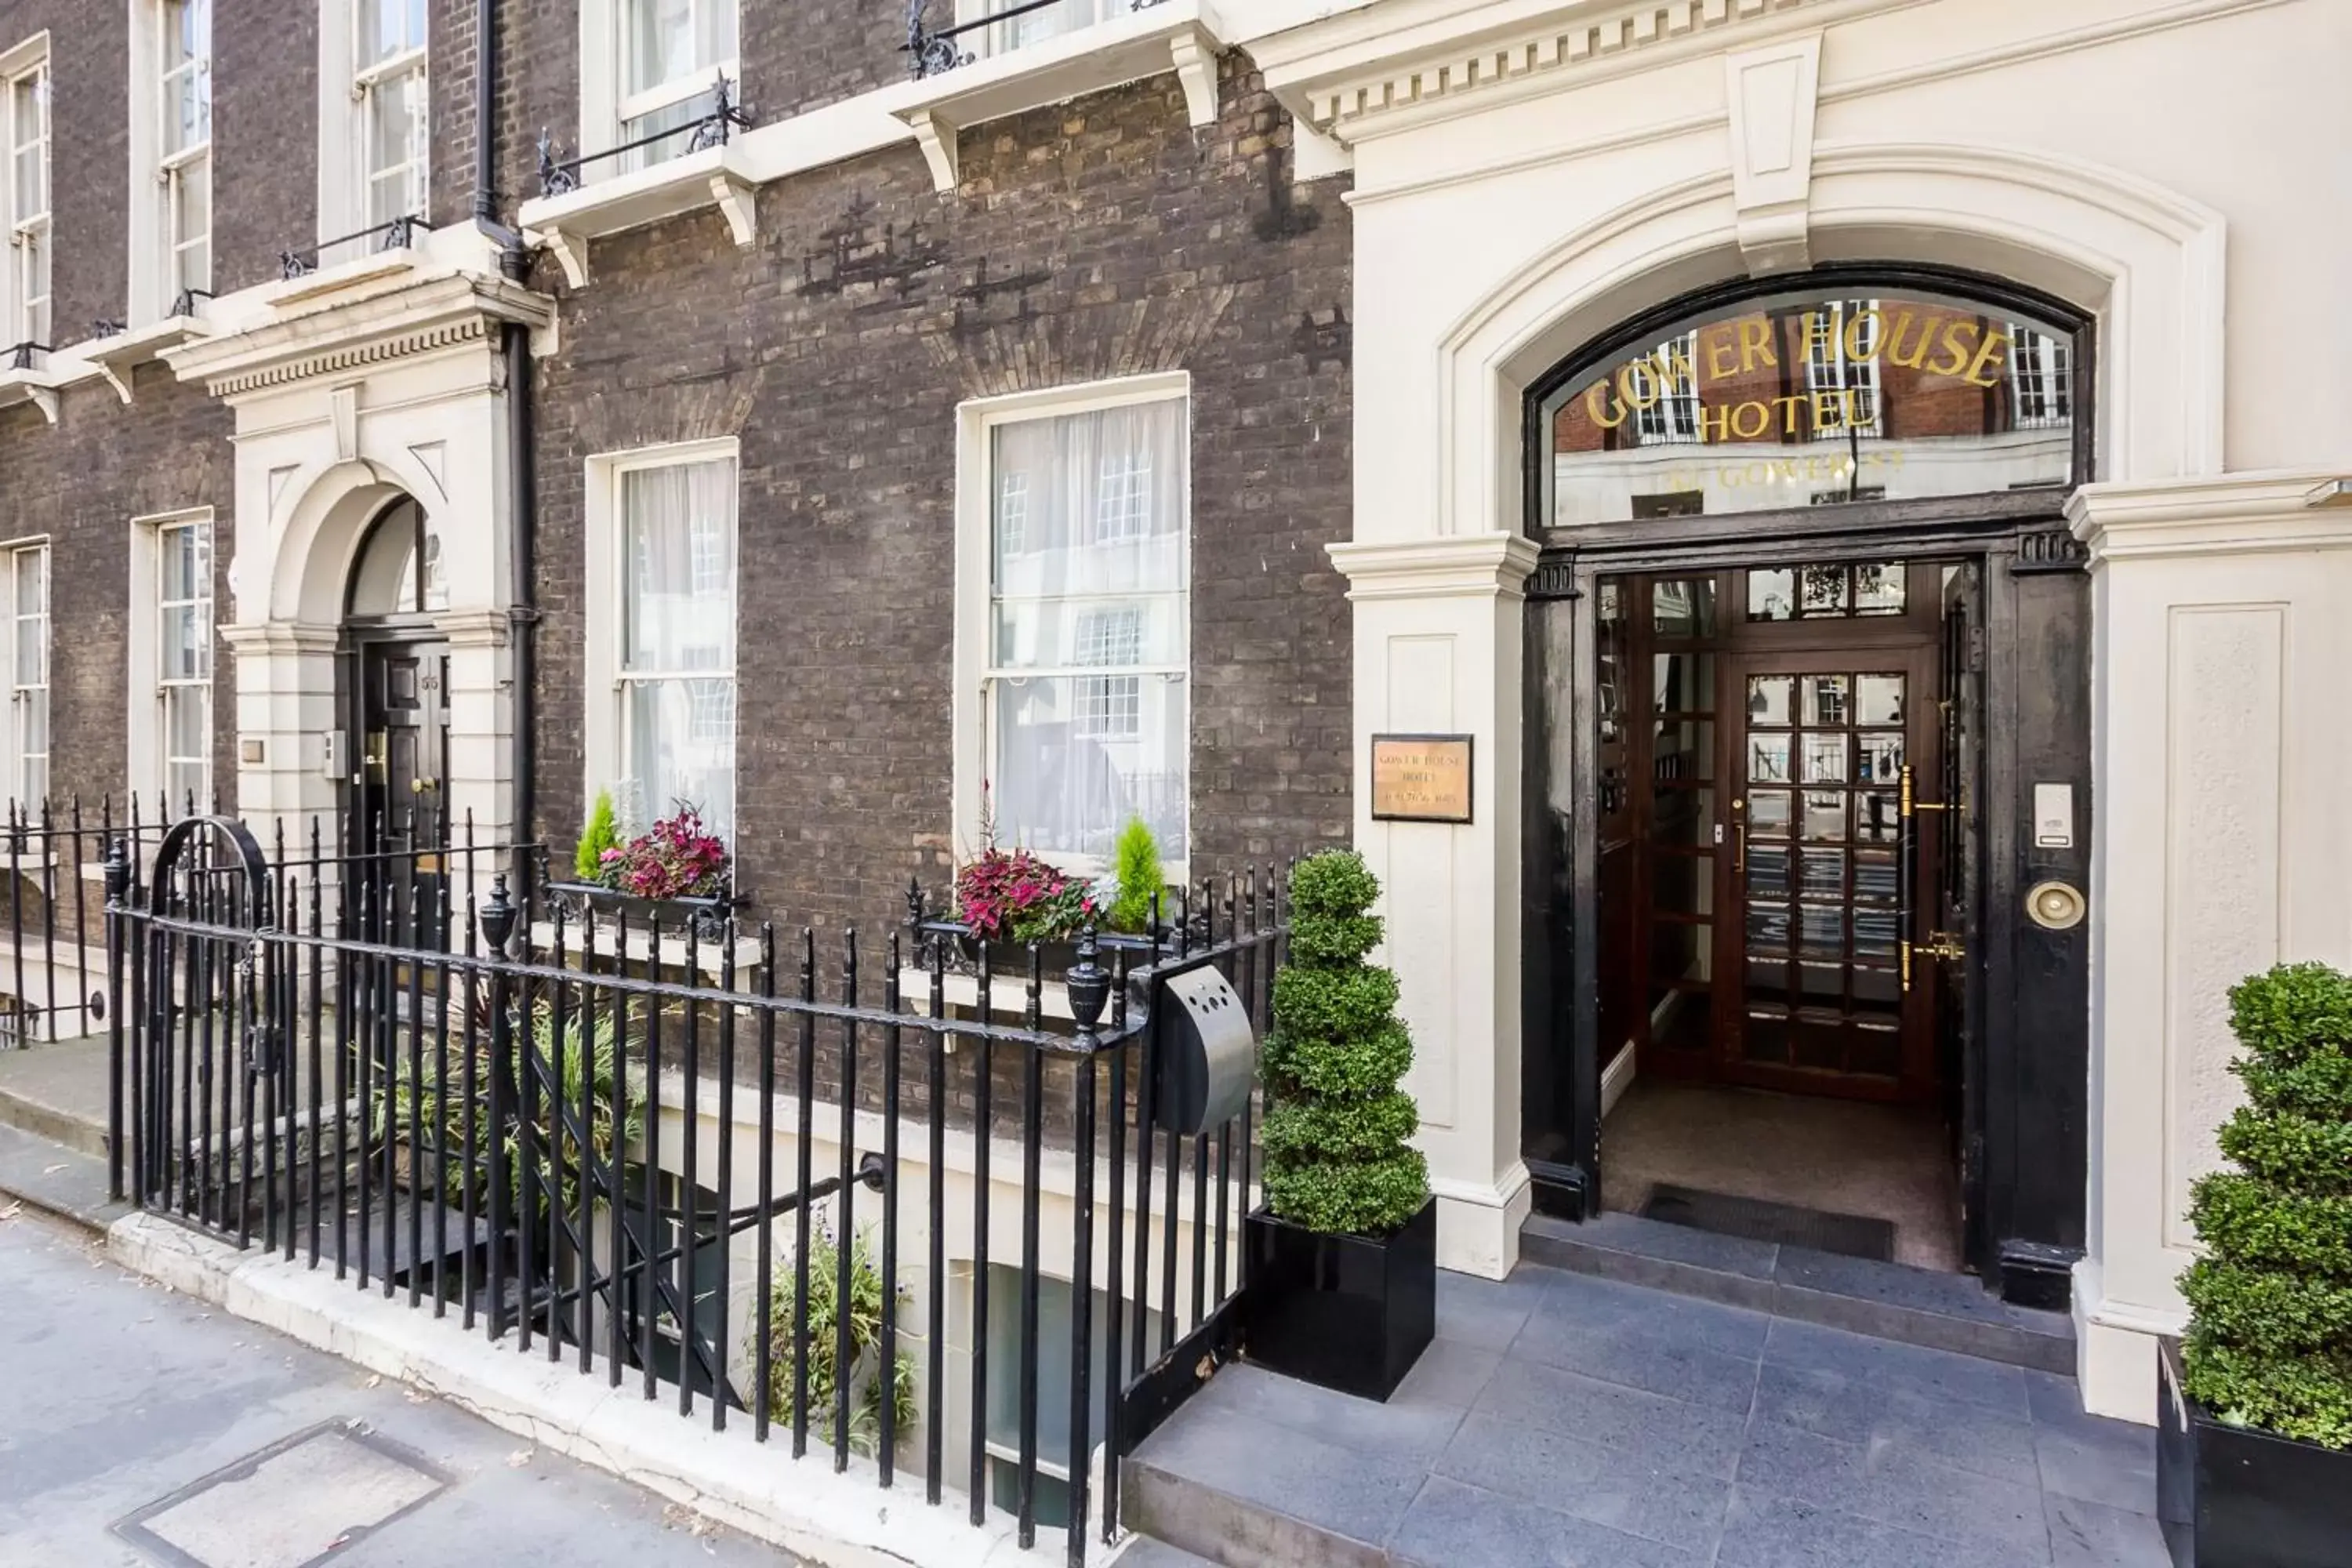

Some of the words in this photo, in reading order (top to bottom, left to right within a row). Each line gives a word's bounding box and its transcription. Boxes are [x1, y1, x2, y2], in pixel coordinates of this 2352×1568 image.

[1587, 315, 1777, 428] GOWER
[1798, 309, 2016, 387] HOUSE
[1698, 389, 1874, 442] HOTEL
